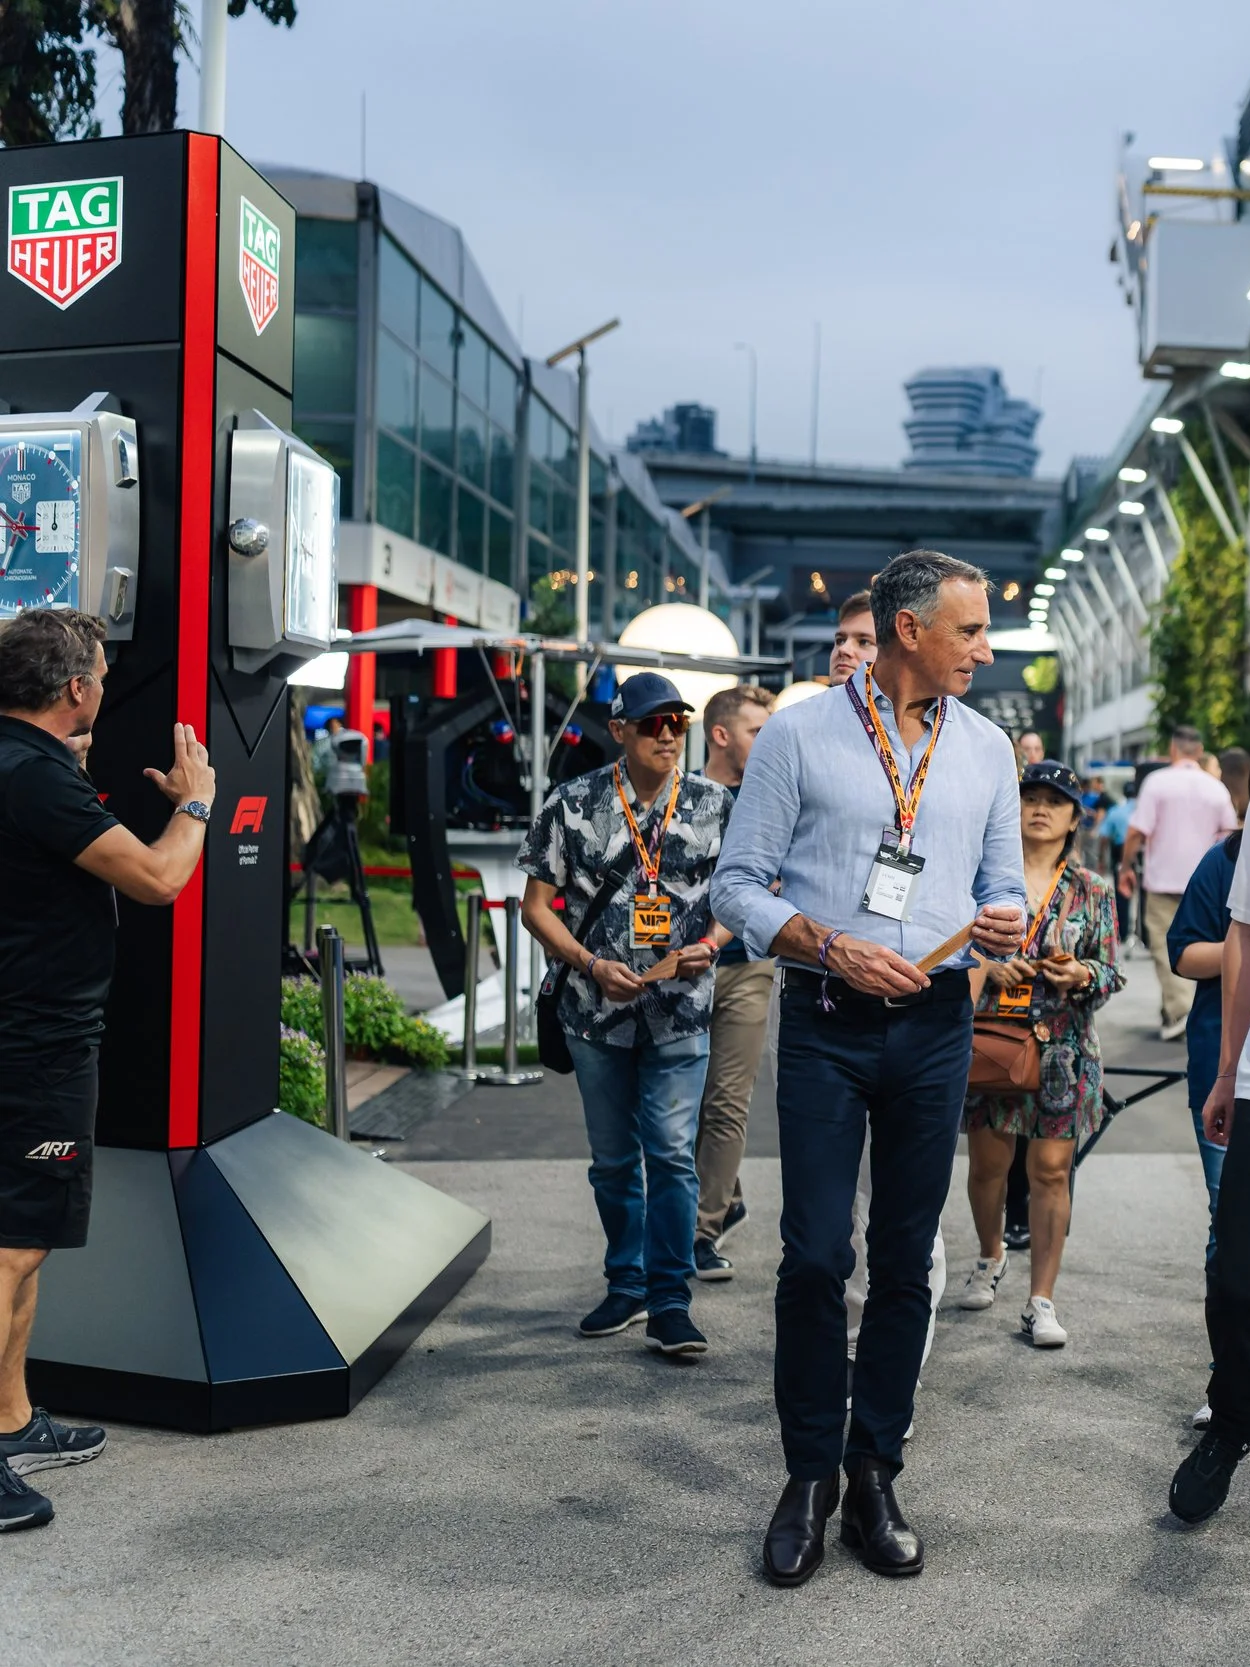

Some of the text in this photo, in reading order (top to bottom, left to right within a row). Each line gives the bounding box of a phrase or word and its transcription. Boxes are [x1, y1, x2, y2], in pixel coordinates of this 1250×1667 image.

[18, 186, 110, 231] TAG
[245, 207, 277, 268] TAG
[14, 235, 113, 299] HEUER
[243, 256, 277, 325] HEUER
[7, 473, 36, 482] MONACO
[13, 484, 30, 492] TAG
[639, 914, 668, 927] VIP
[1005, 988, 1031, 999] VIP
[28, 1142, 76, 1156] ART
